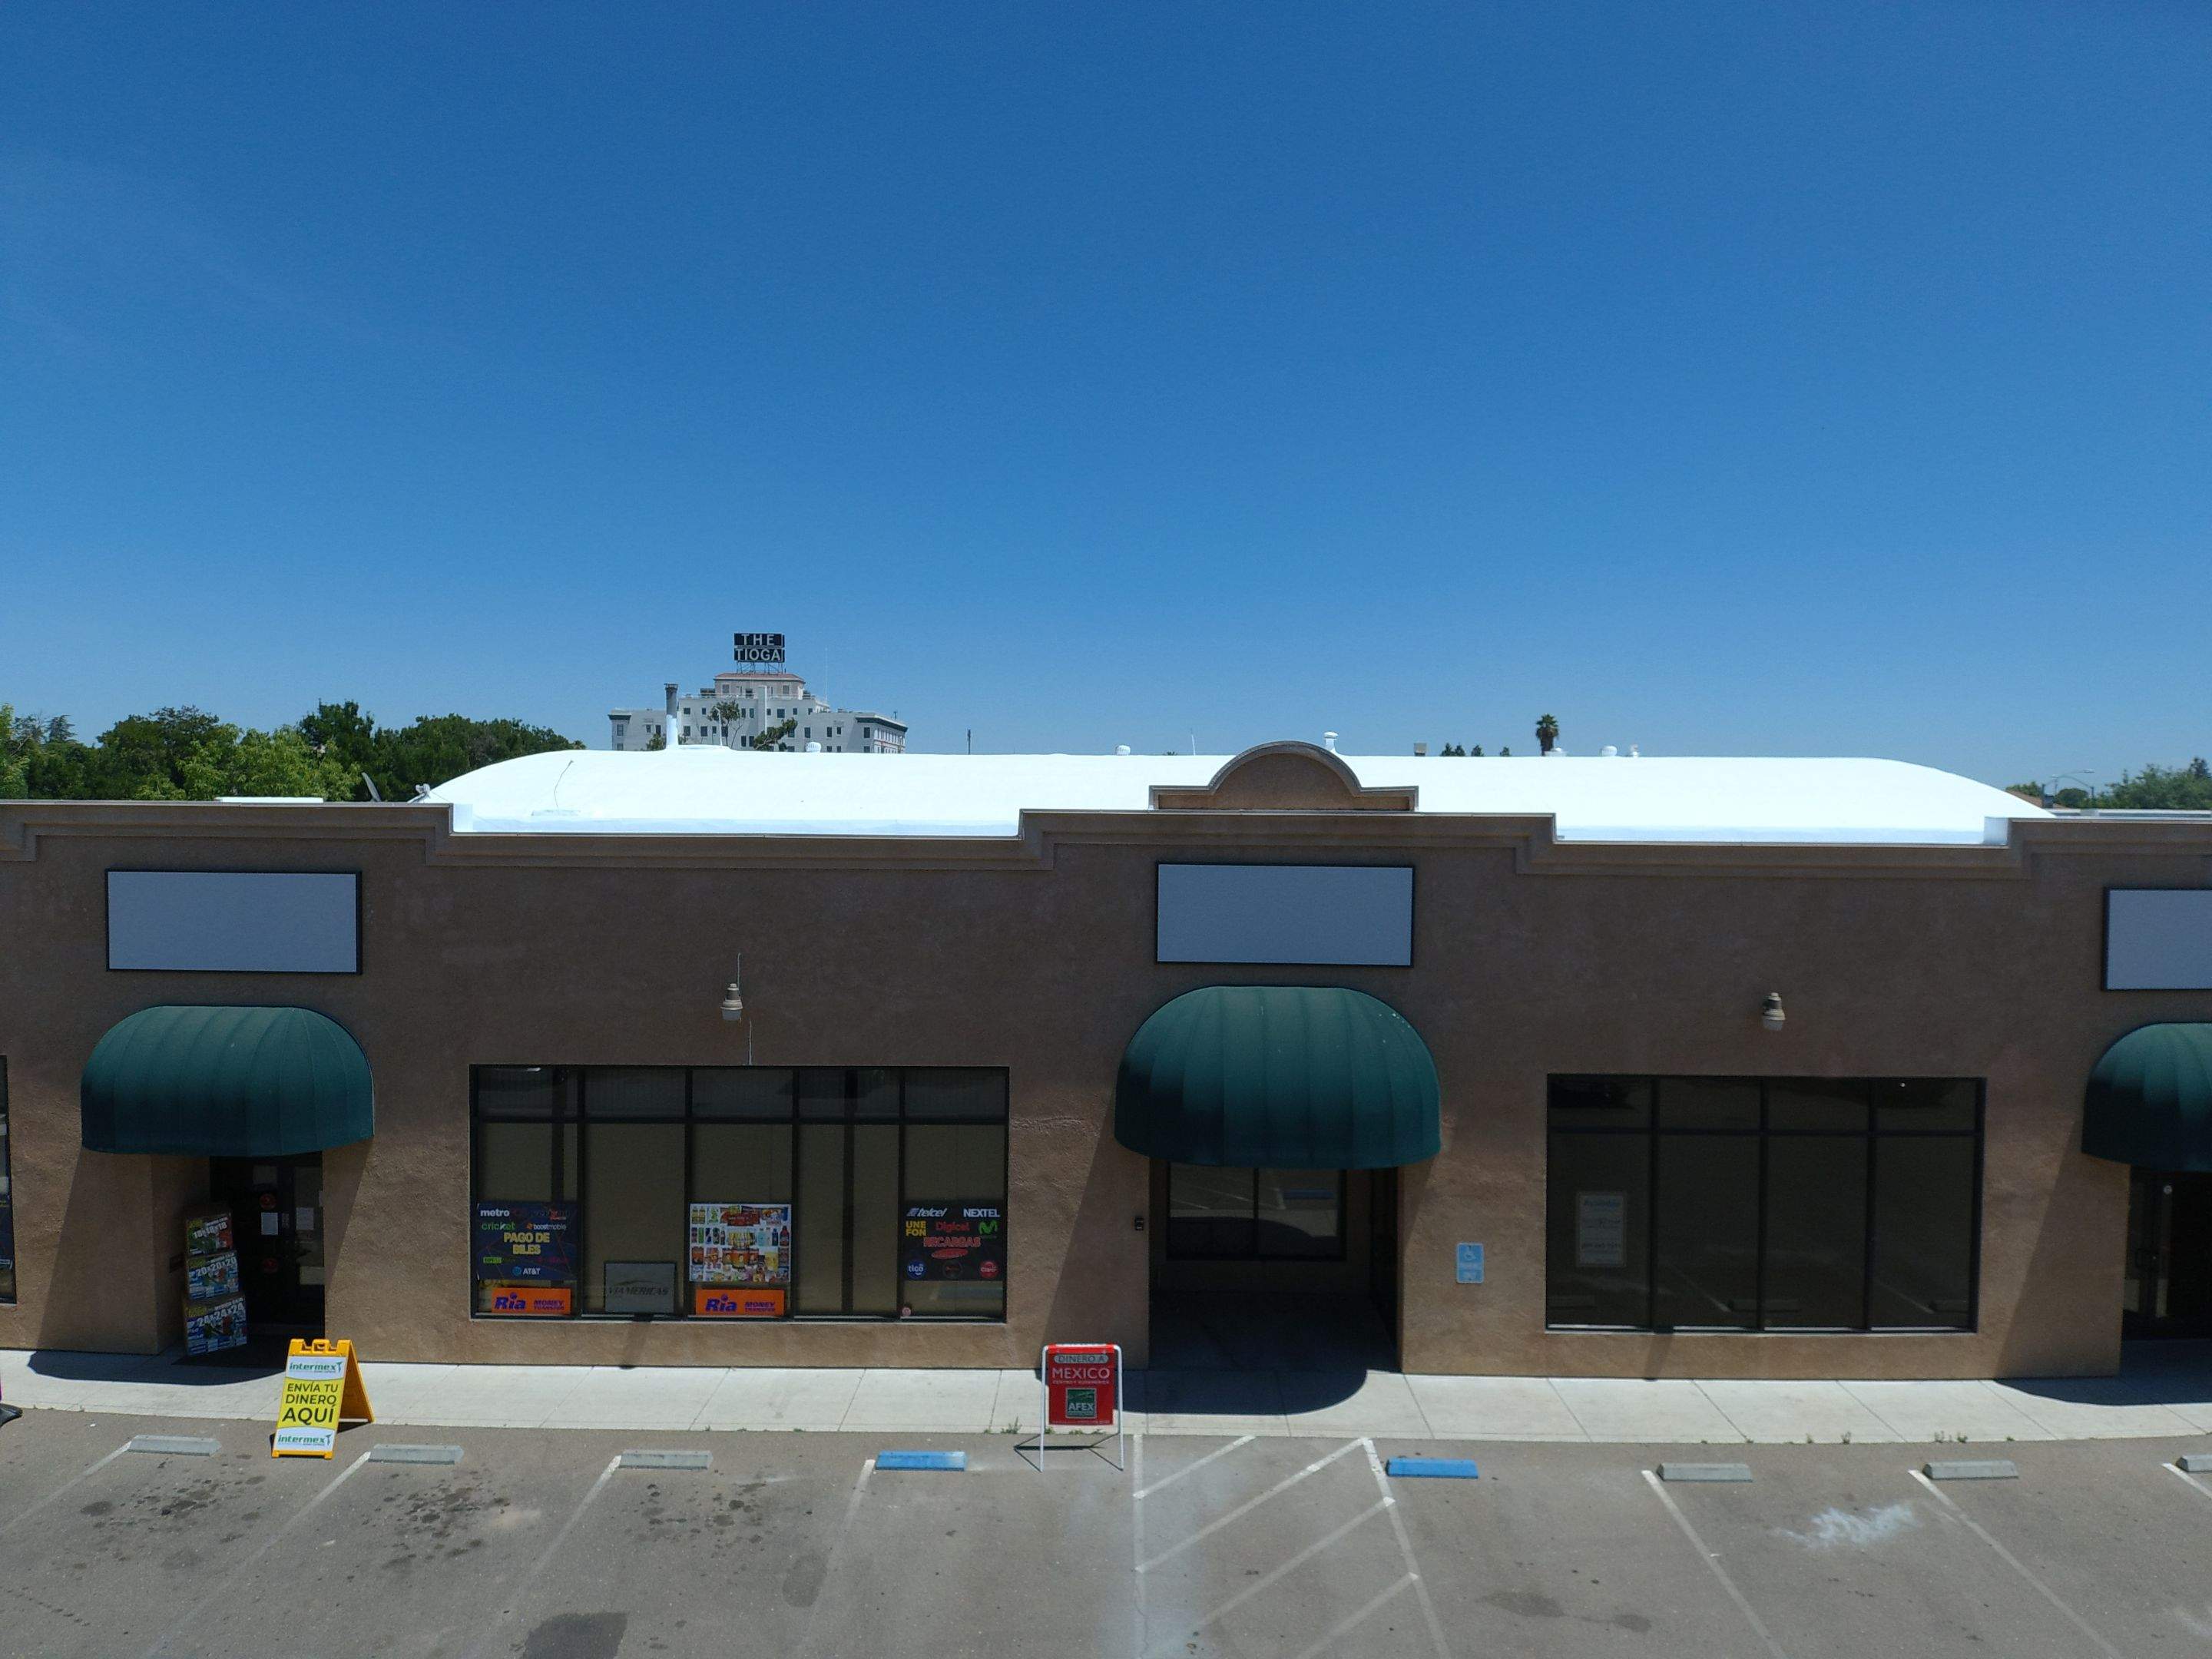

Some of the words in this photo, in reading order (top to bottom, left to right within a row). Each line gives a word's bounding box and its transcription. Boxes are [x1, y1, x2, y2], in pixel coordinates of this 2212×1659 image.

[741, 634, 775, 646] THE
[735, 648, 780, 661] TIOGA
[480, 1208, 510, 1217] metro
[918, 1207, 948, 1217] telcel
[963, 1208, 1001, 1218] NEXTEL
[481, 1220, 517, 1231] cricket
[906, 1220, 927, 1229] UNE
[503, 1231, 534, 1243] PAGO
[535, 1231, 551, 1243] DE
[906, 1228, 927, 1237] FON
[522, 1267, 541, 1276] AT&T
[494, 1292, 526, 1310] Ria
[705, 1293, 737, 1312] Ria
[289, 1362, 336, 1371] intermex
[1051, 1368, 1111, 1379] MEXICO
[286, 1382, 321, 1392] ENVÍA
[323, 1383, 339, 1393] TU
[285, 1394, 337, 1406] DINERO
[1068, 1402, 1094, 1411] AFEX
[281, 1405, 335, 1426] AQUÍ
[277, 1434, 326, 1444] intermex
